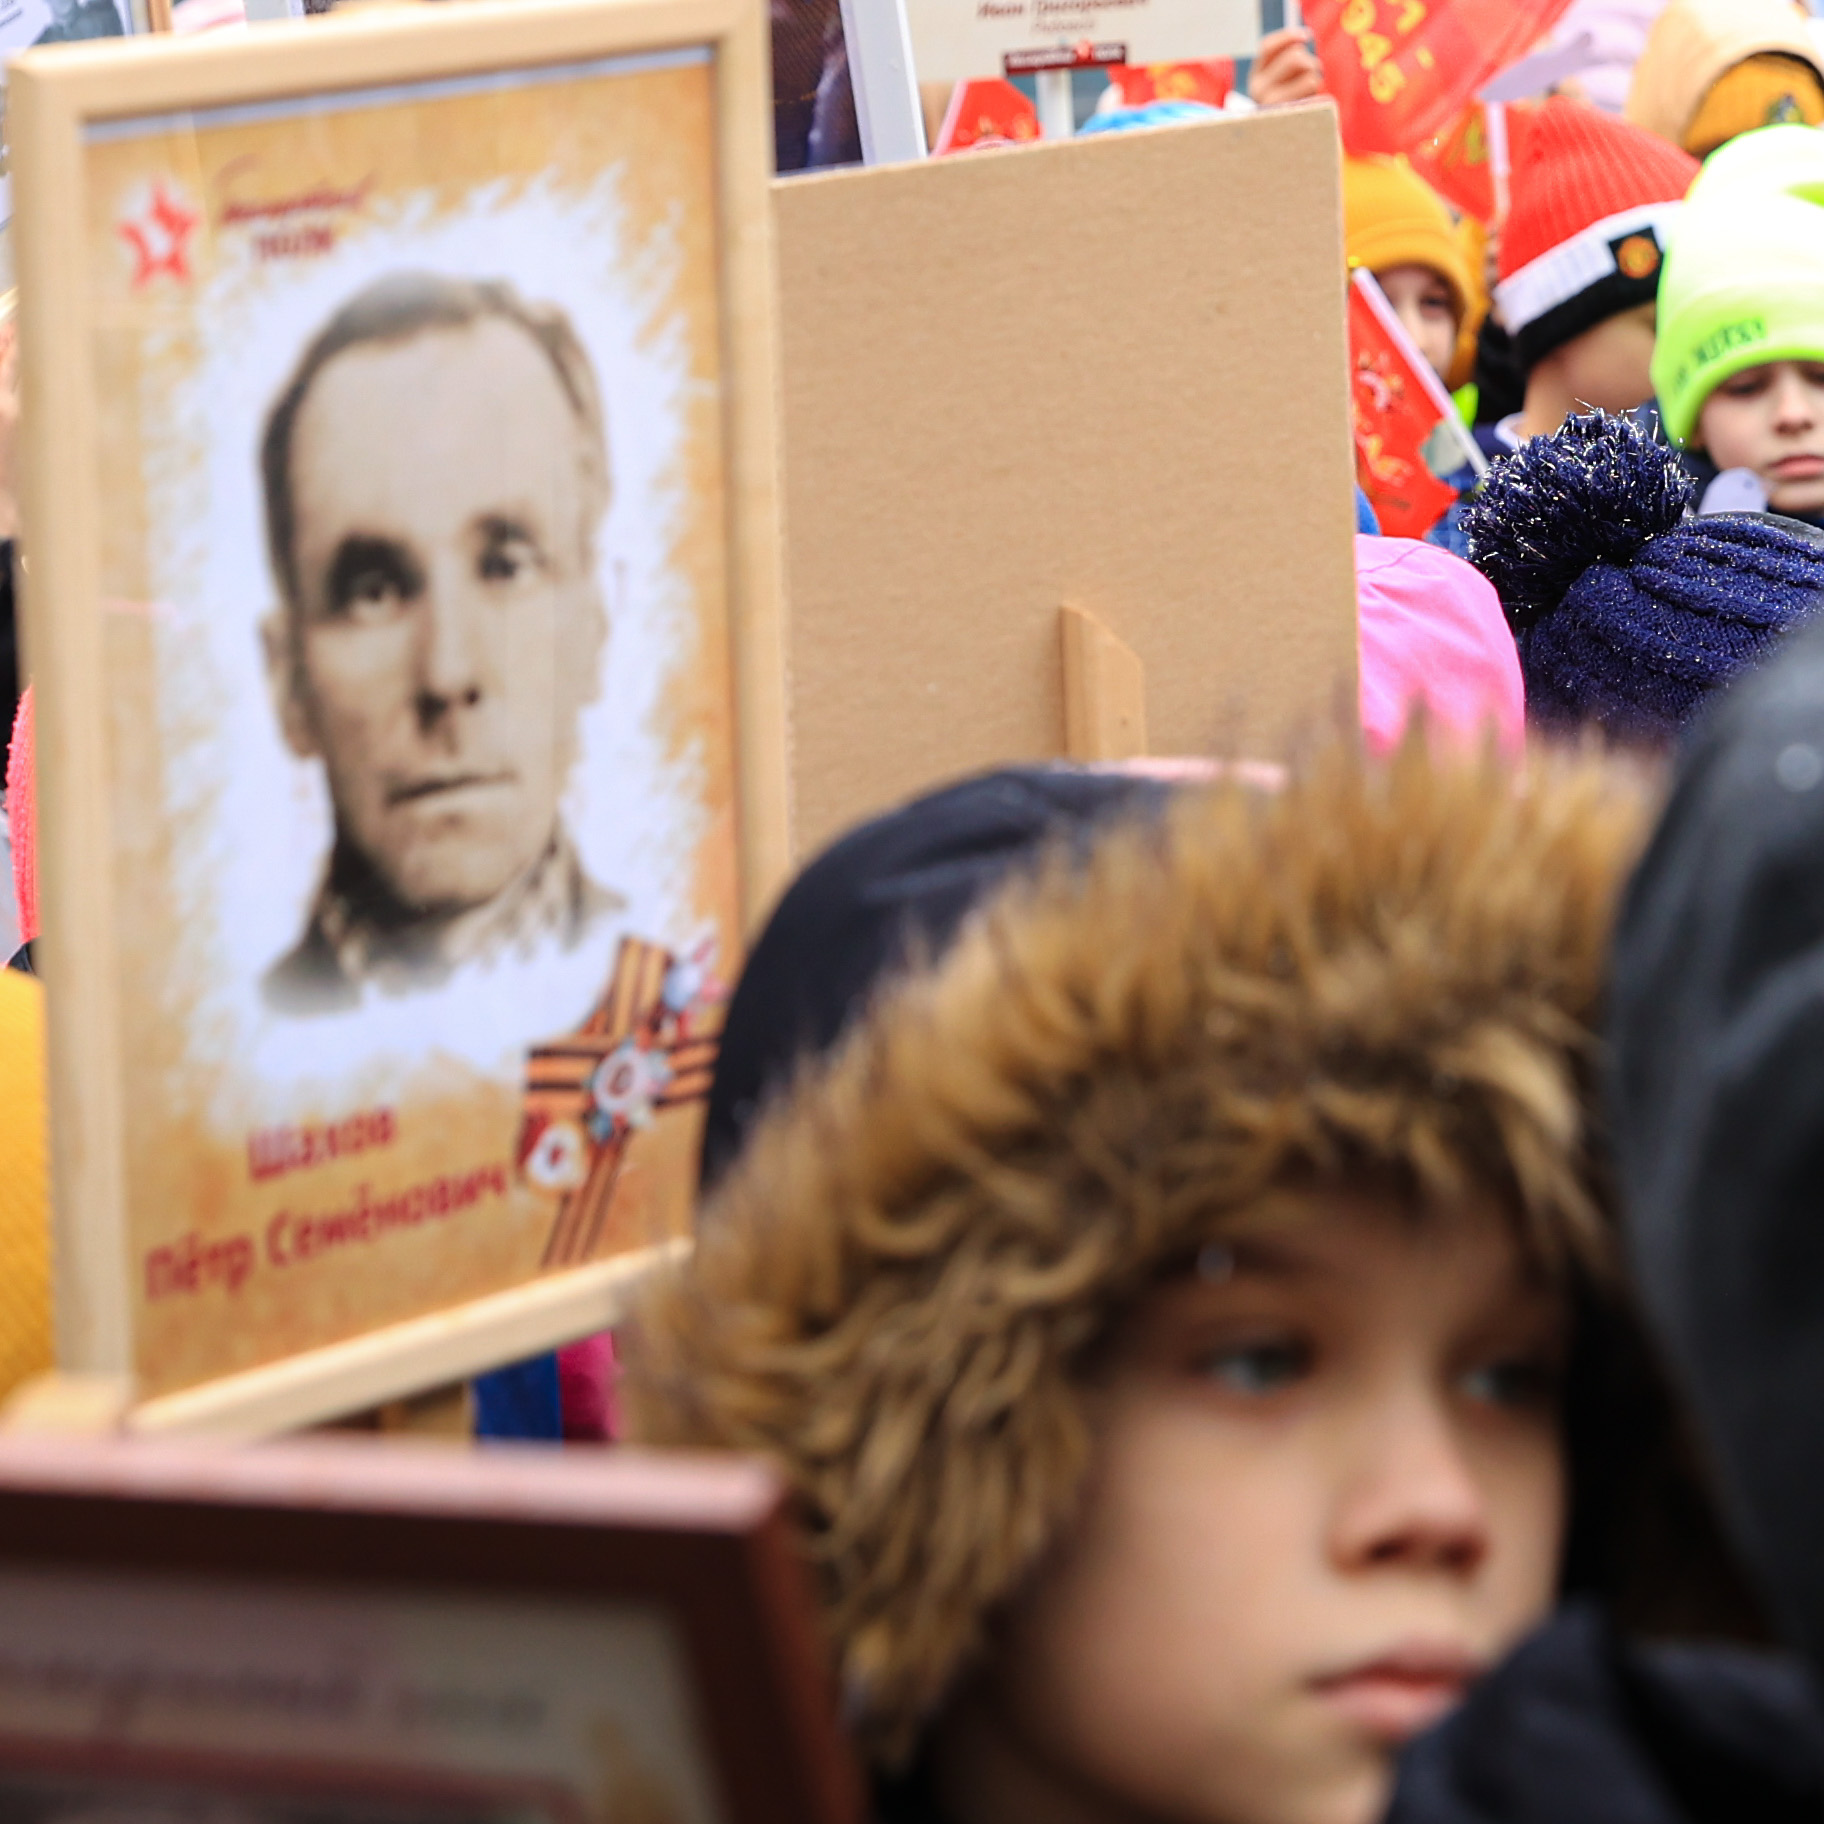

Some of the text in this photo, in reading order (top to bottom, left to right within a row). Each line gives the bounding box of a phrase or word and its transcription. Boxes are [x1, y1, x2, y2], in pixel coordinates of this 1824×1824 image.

[247, 1104, 398, 1184] Шахов
[144, 1161, 509, 1305] Пётр Семёнович
